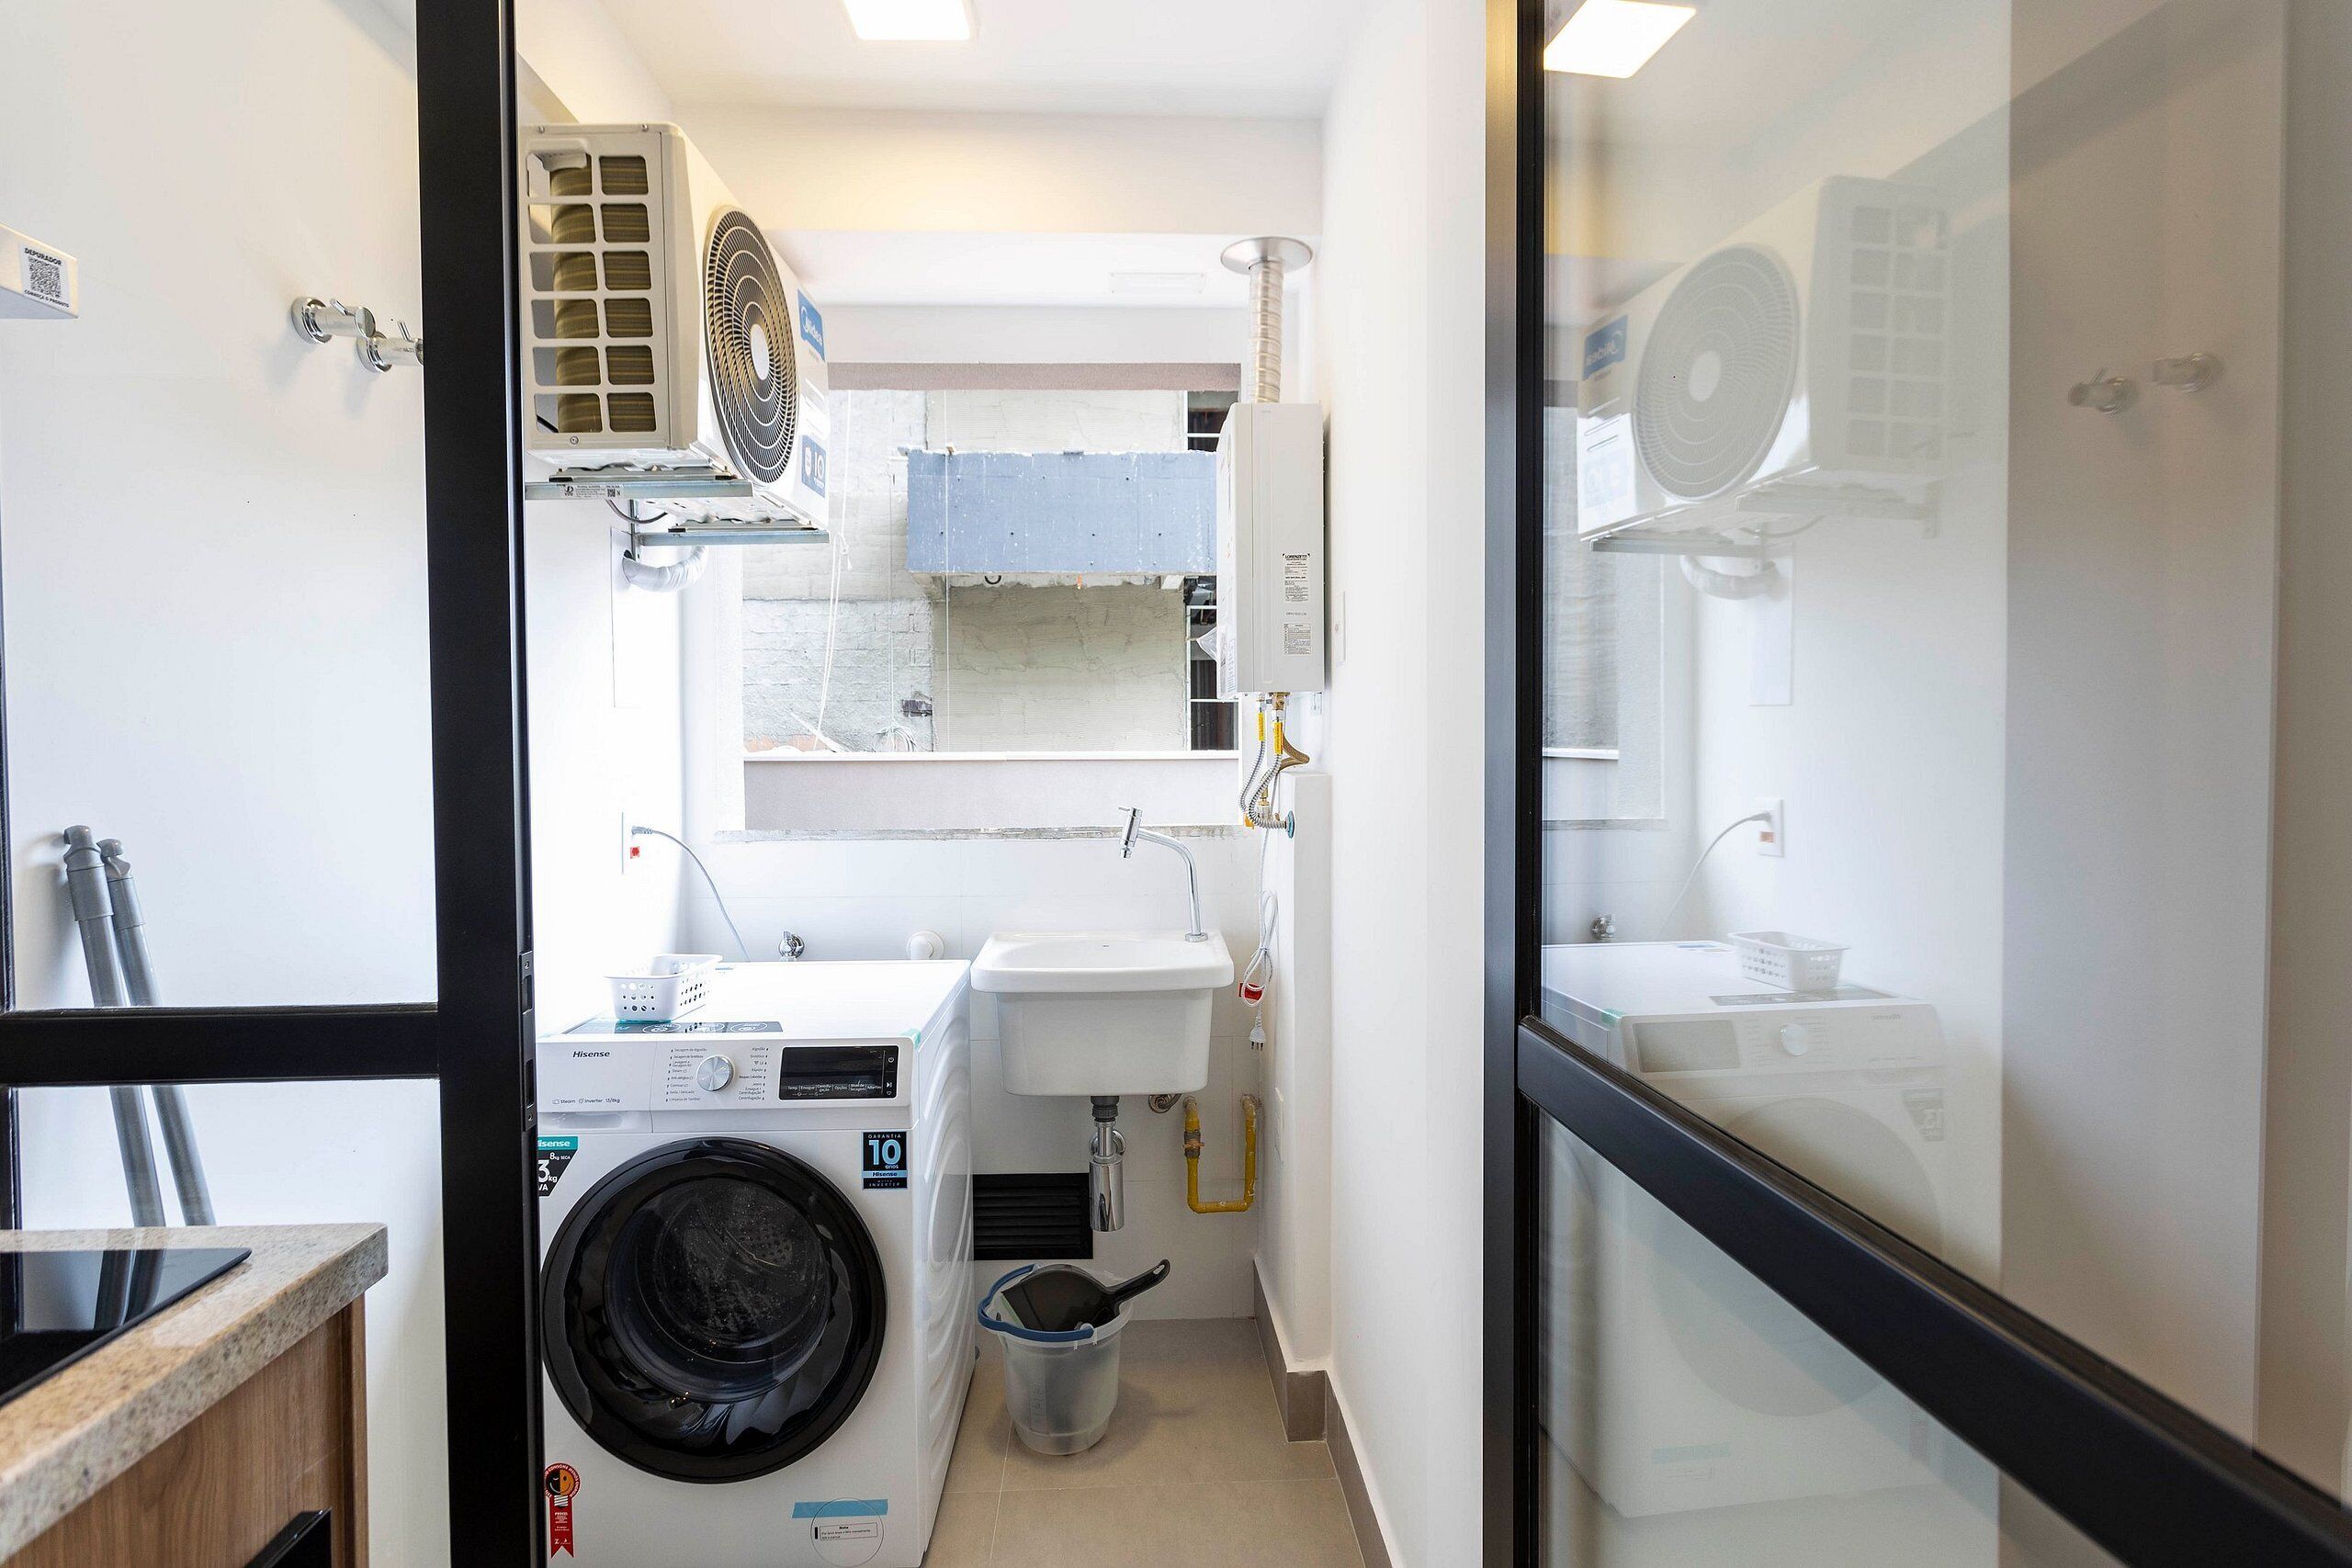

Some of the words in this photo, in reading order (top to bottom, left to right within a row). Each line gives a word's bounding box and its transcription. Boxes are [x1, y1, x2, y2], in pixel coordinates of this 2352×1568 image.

[24, 247, 62, 265] DEPURADOR
[801, 309, 823, 346] Midea
[572, 1050, 611, 1058] Hisense
[549, 1152, 560, 1160] 8kg
[868, 1139, 901, 1166] 10
[538, 1159, 558, 1183] 3kg
